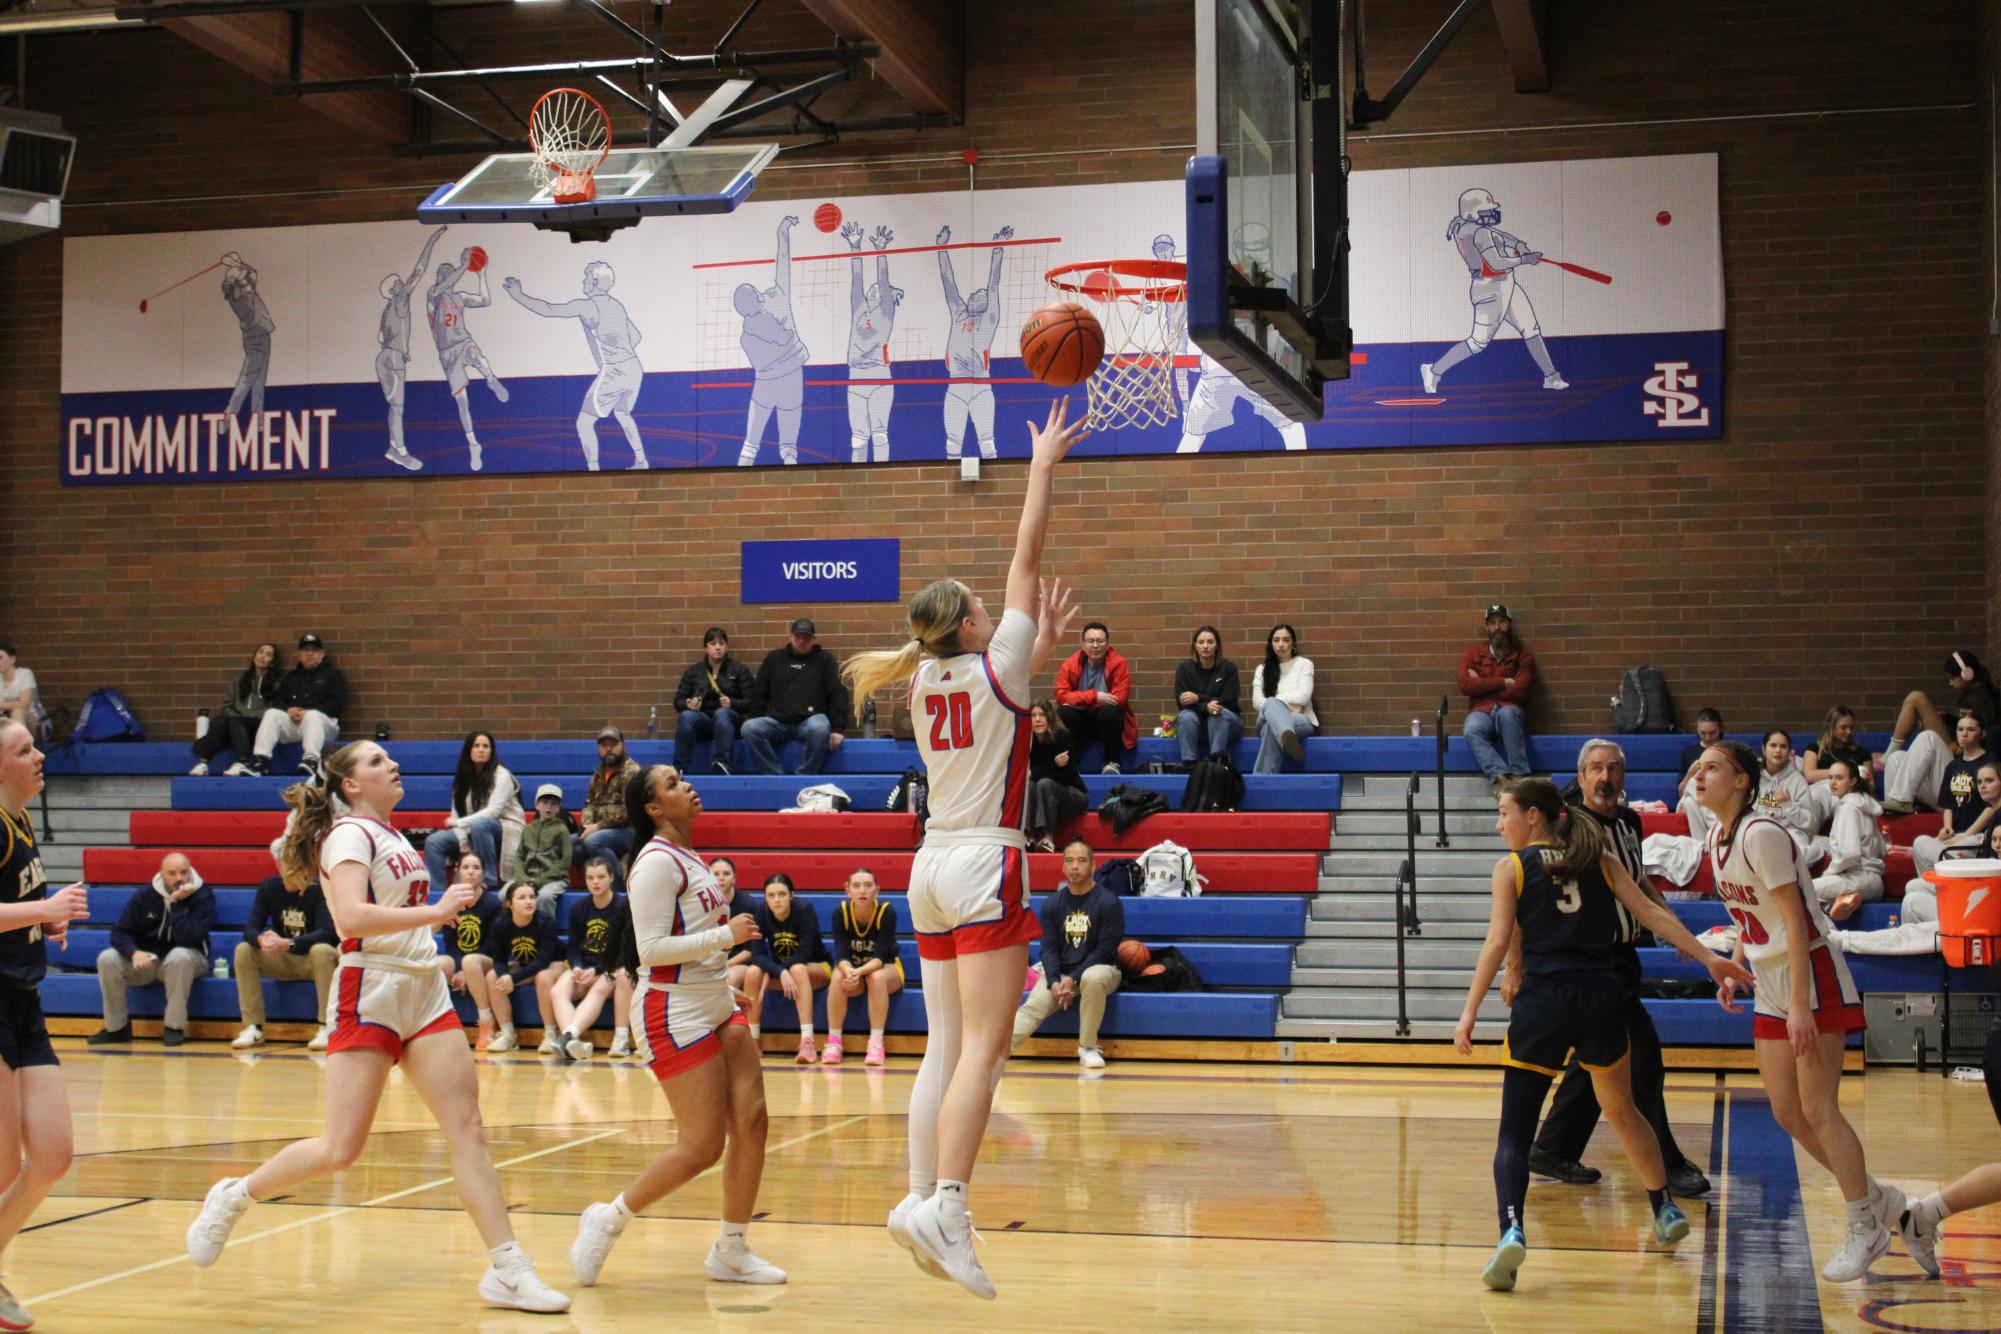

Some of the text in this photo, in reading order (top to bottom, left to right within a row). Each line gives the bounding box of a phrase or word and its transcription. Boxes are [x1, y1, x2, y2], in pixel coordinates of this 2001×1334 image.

[68, 408, 337, 477] COMMITMENT
[782, 561, 858, 580] VISITORS
[925, 691, 975, 752] 20
[1552, 876, 1582, 914] 3
